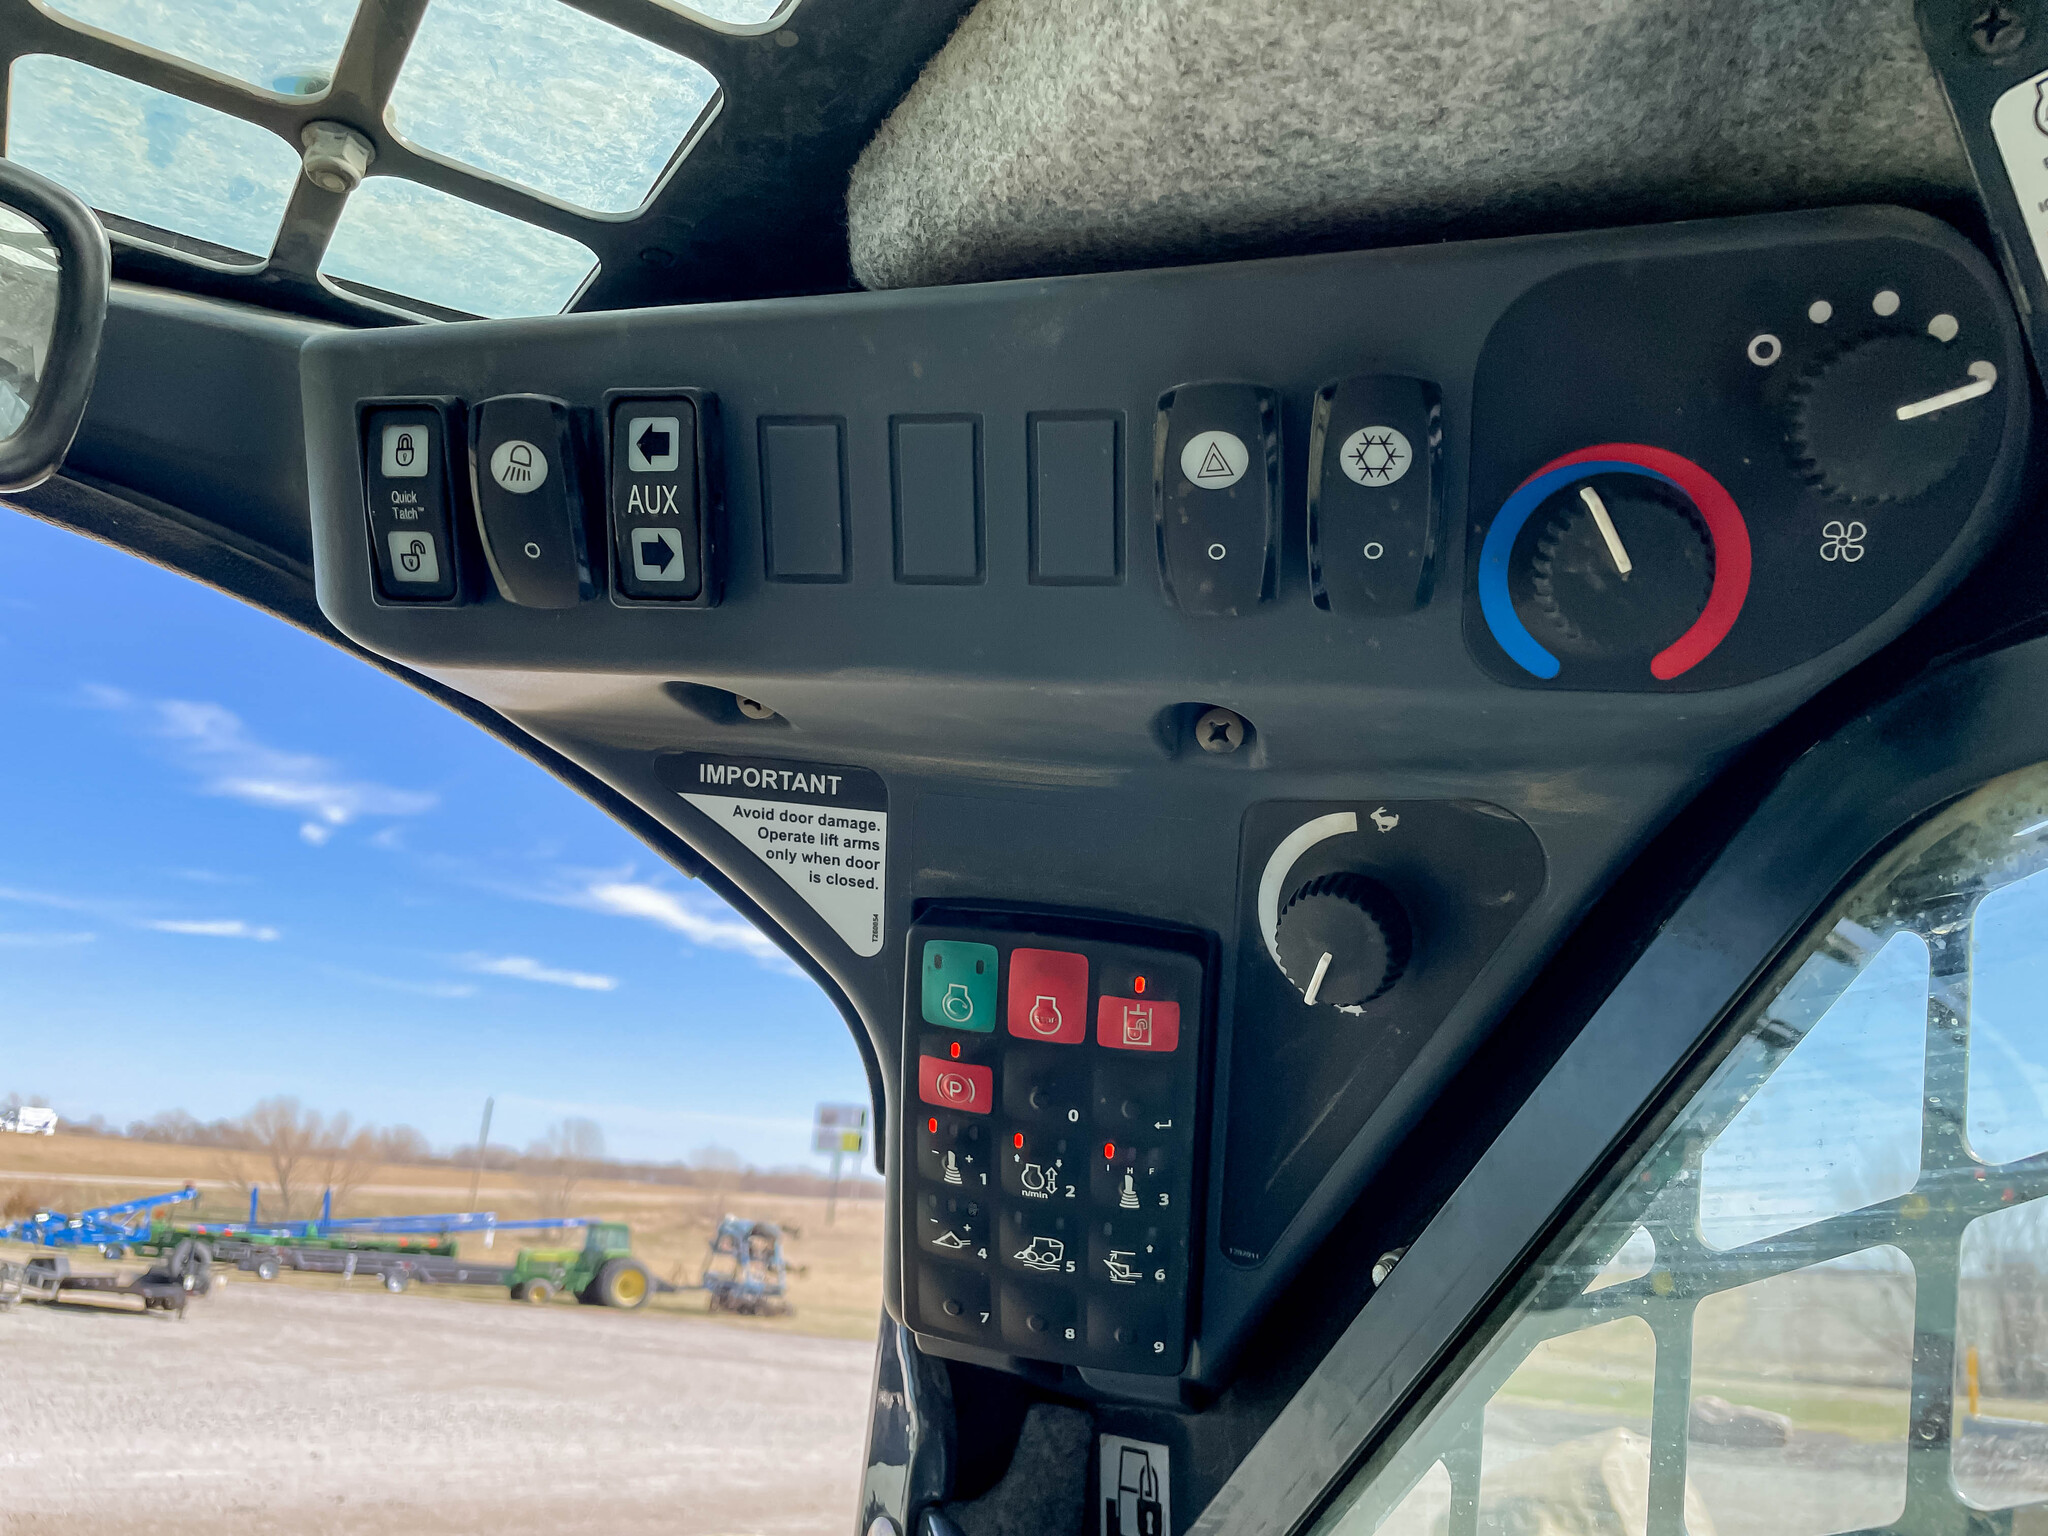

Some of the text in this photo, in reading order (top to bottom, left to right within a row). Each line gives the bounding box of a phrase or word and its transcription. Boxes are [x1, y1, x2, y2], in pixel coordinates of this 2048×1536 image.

[391, 490, 418, 504] Quick
[627, 484, 680, 515] AUX
[699, 763, 842, 795] IMPORTANT
[732, 804, 881, 833] Avoid door damage.
[757, 826, 880, 851] Operate lift arms
[765, 848, 881, 871] only when door
[809, 870, 879, 890] is closed.
[949, 1080, 962, 1098] P
[1067, 1108, 1080, 1122] 0
[979, 1172, 987, 1186] 1
[1021, 1189, 1049, 1199] n/min
[1065, 1185, 1076, 1198] 2
[1158, 1193, 1170, 1206] 3
[977, 1247, 988, 1260] 4
[1065, 1260, 1076, 1273] 5
[1154, 1268, 1166, 1281] 6
[980, 1312, 990, 1324] 7
[1064, 1328, 1076, 1340] 8
[1153, 1341, 1165, 1353] 9
